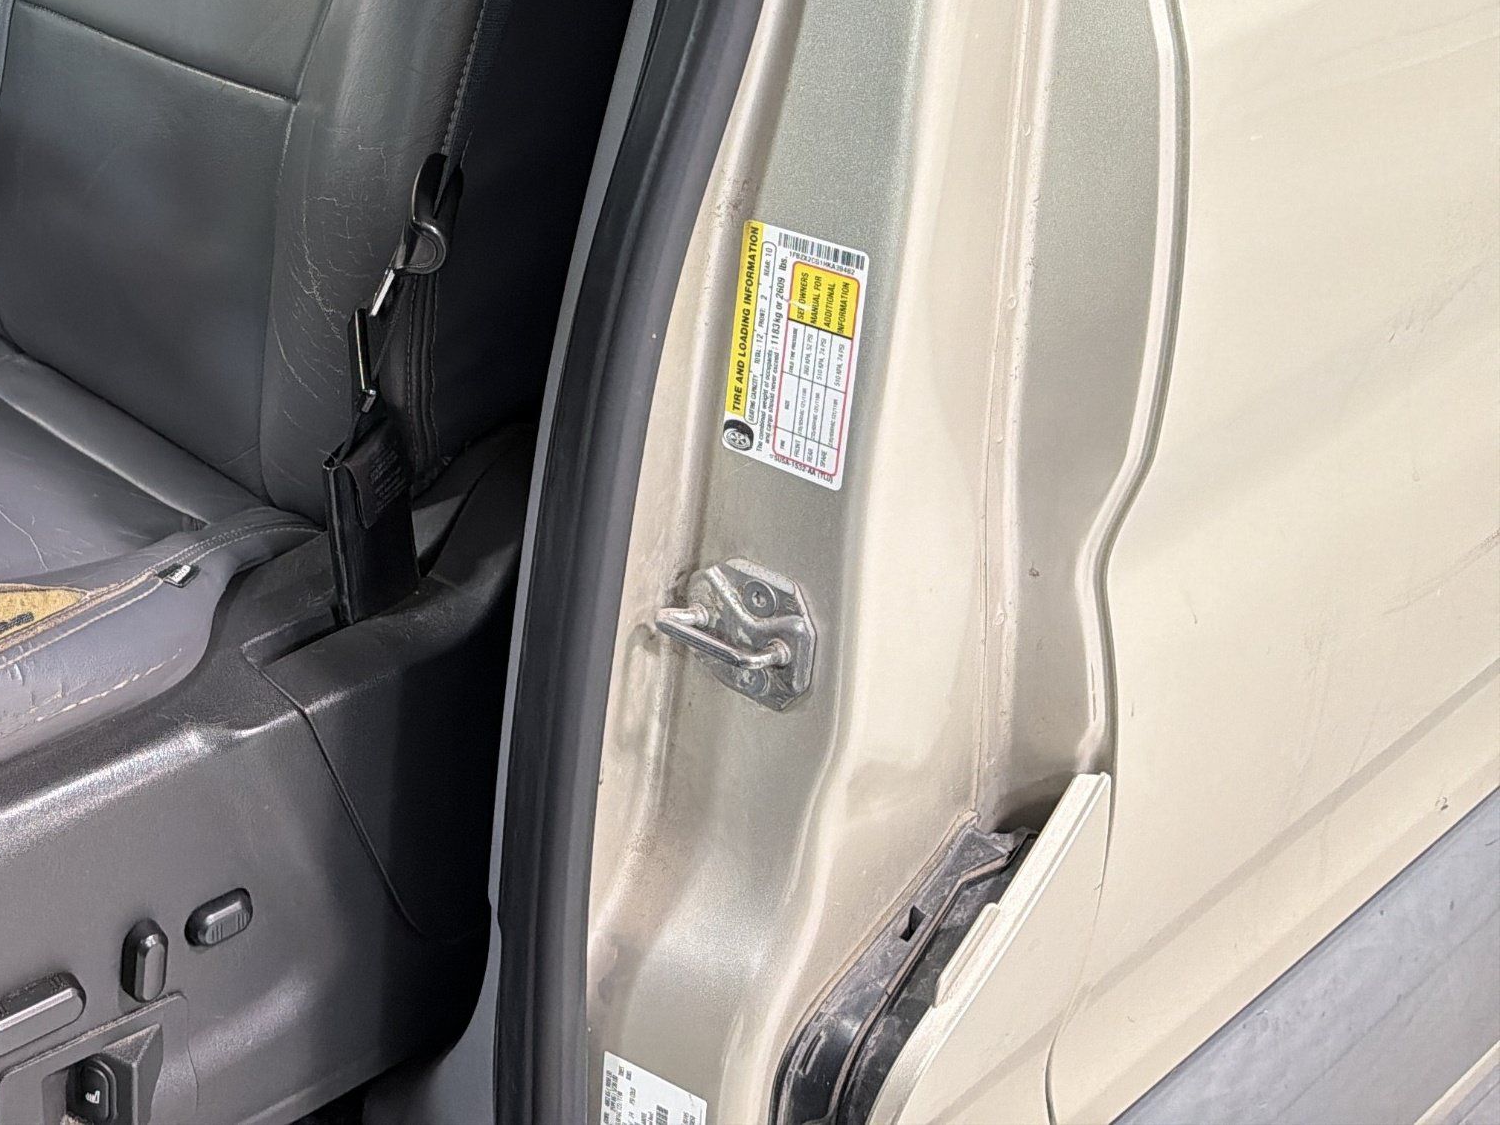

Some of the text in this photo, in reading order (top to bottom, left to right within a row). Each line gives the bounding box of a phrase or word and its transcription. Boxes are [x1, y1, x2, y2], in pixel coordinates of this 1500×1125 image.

[765, 247, 772, 257] 10
[778, 254, 787, 271] lbs.
[775, 276, 785, 300] 2609
[798, 271, 808, 304] OWNERS
[809, 274, 822, 324] MANUAL FOR
[775, 300, 782, 310] or
[823, 281, 835, 327] ADDITIONAL
[836, 281, 850, 334] INFORMATION
[732, 225, 758, 412] TIRE AND LOADING INFORMATION
[756, 333, 762, 343] 12
[806, 343, 812, 351] 52
[819, 347, 825, 355] 74
[764, 349, 773, 380] occupants
[750, 374, 758, 400] CAPACITY
[761, 388, 769, 410] weight
[757, 410, 766, 440] combined
[793, 439, 801, 458] FRONT
[819, 449, 827, 467] SPARE
